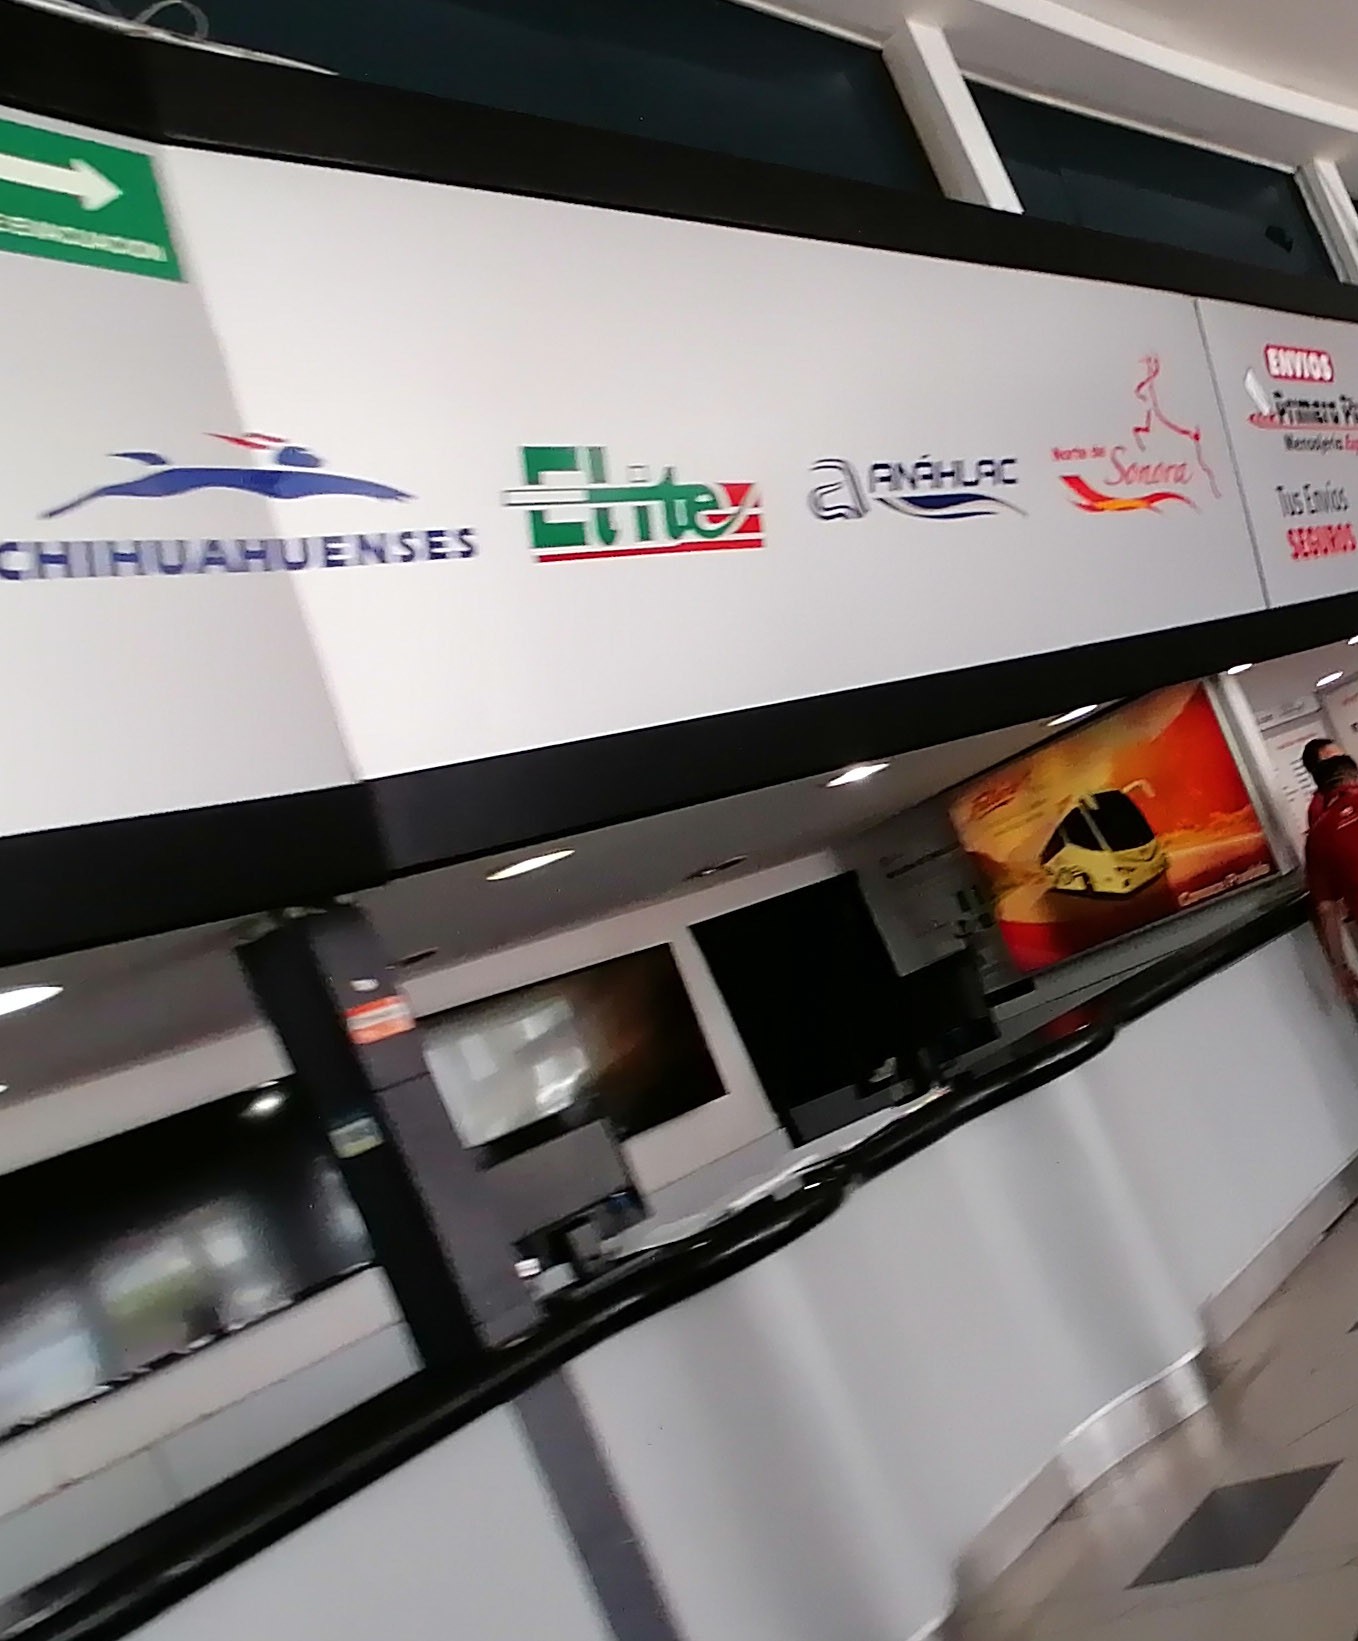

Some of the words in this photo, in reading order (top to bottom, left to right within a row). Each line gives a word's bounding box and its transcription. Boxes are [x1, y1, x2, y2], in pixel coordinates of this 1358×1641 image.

[1266, 347, 1332, 382] ENVIOS
[1273, 391, 1339, 424] Primera
[1104, 445, 1193, 485] Sonora
[502, 446, 762, 547] Elite
[1276, 486, 1303, 517] Tus
[0, 526, 478, 581] CHIHUAHUENSES
[1286, 523, 1357, 560] SEGUROS
